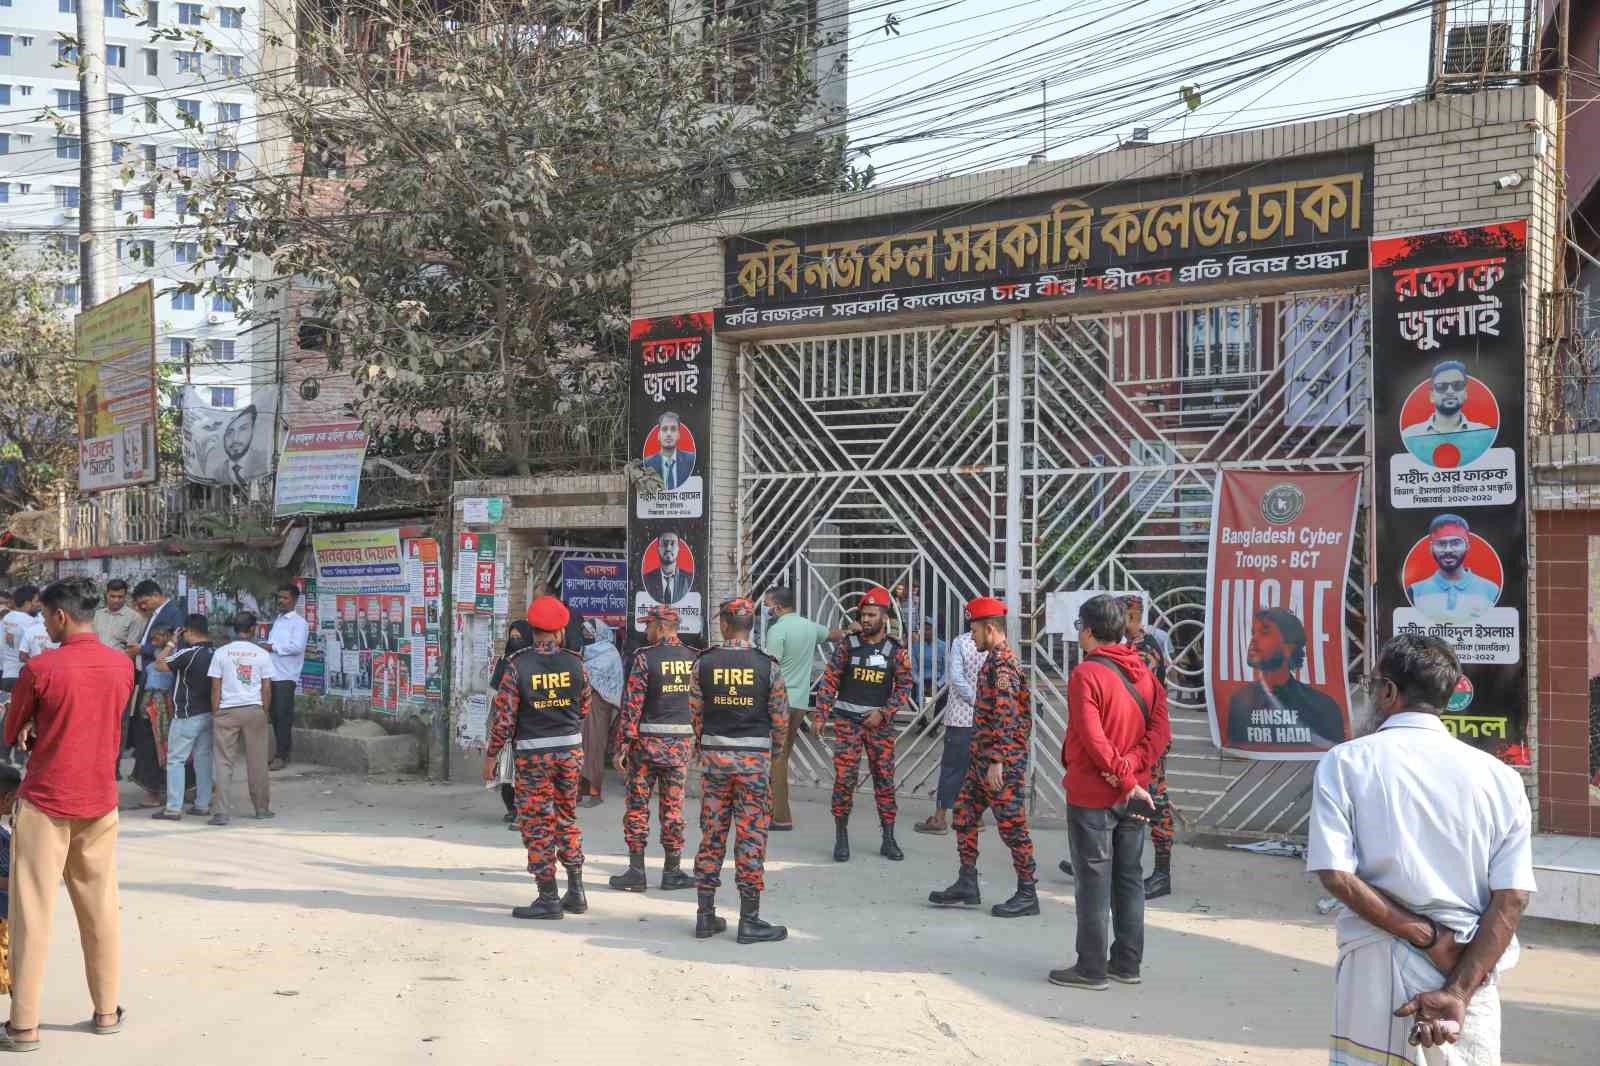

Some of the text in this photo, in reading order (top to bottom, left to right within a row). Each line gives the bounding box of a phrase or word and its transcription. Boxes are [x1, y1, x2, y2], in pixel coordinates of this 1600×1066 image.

[737, 239, 800, 298] কবি
[804, 231, 937, 289] নজরুল
[943, 199, 1094, 273] সরকারি
[1248, 172, 1363, 241] ঢাকা
[725, 249, 1349, 327] কবি নজরুল সরকারি কলেজের চার বীর শহীদের প্রতি বিনম্র শ্রদ্ধা
[1397, 294, 1503, 350] জুলাই
[643, 363, 700, 402] জুলাই
[1397, 468, 1508, 485] শহীদ ওমর ফারুক
[1221, 526, 1344, 549] Bangladesh Cyber
[1234, 550, 1279, 572] Troops
[1289, 550, 1321, 569] BCT
[1475, 623, 1515, 638] ইসলাম
[661, 660, 693, 675] FIRE
[853, 666, 886, 684] FIRE
[531, 672, 571, 690] FIRE
[674, 675, 682, 684] &
[713, 668, 754, 686] FIRE
[549, 689, 557, 699] &
[662, 684, 691, 694] RESCU
[729, 686, 737, 696] &
[533, 698, 571, 709] RESCUE
[713, 696, 754, 707] RESCUE
[1250, 708, 1300, 725] #INSAF
[1247, 727, 1312, 743] FOR HADI
